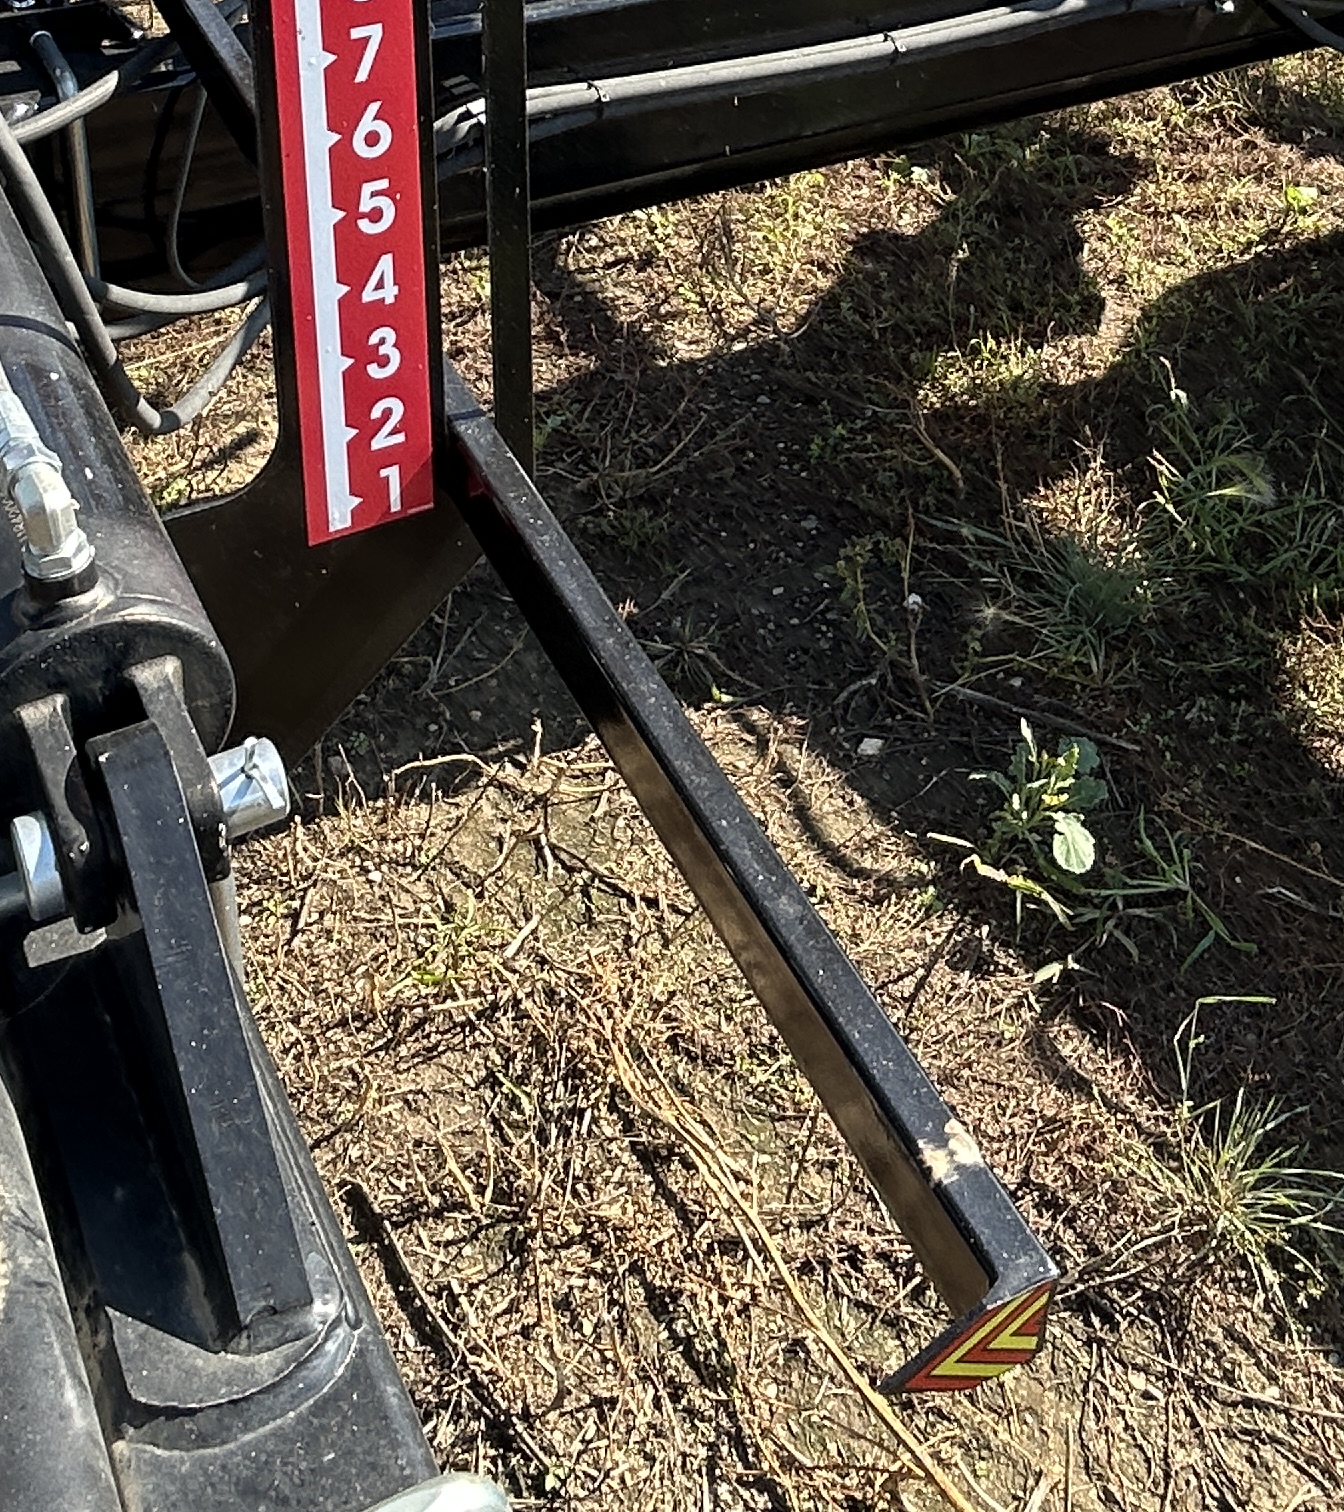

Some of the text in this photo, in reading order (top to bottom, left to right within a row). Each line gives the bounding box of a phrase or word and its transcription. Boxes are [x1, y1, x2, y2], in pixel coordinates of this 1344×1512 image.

[349, 24, 383, 83] 7
[352, 100, 392, 159] 6
[357, 178, 396, 235] 5
[361, 254, 398, 305] 4
[366, 326, 400, 379] 3
[370, 396, 406, 451] 2
[379, 465, 402, 513] 1
